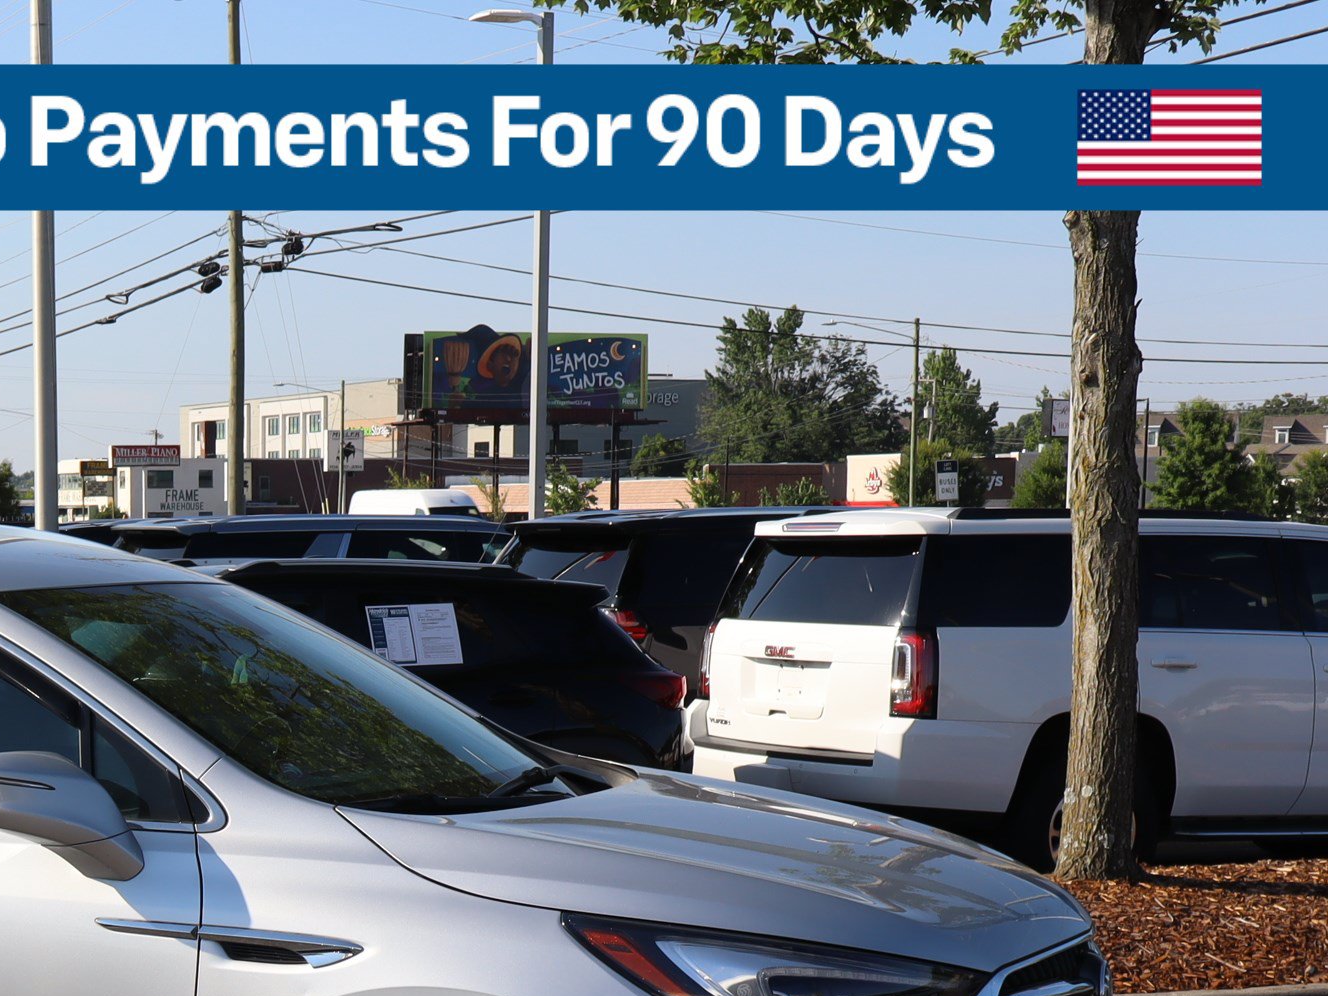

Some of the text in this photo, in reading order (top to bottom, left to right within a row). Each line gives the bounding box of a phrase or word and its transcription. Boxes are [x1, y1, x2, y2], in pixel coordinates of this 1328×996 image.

[550, 351, 610, 373] LEAMOS
[559, 371, 625, 395] JUNTOS
[647, 391, 679, 406] orage
[115, 447, 178, 457] MILLER PIANO
[165, 489, 199, 501] FRAME
[160, 502, 204, 511] WAREHOUSE
[764, 645, 796, 658] GMC
